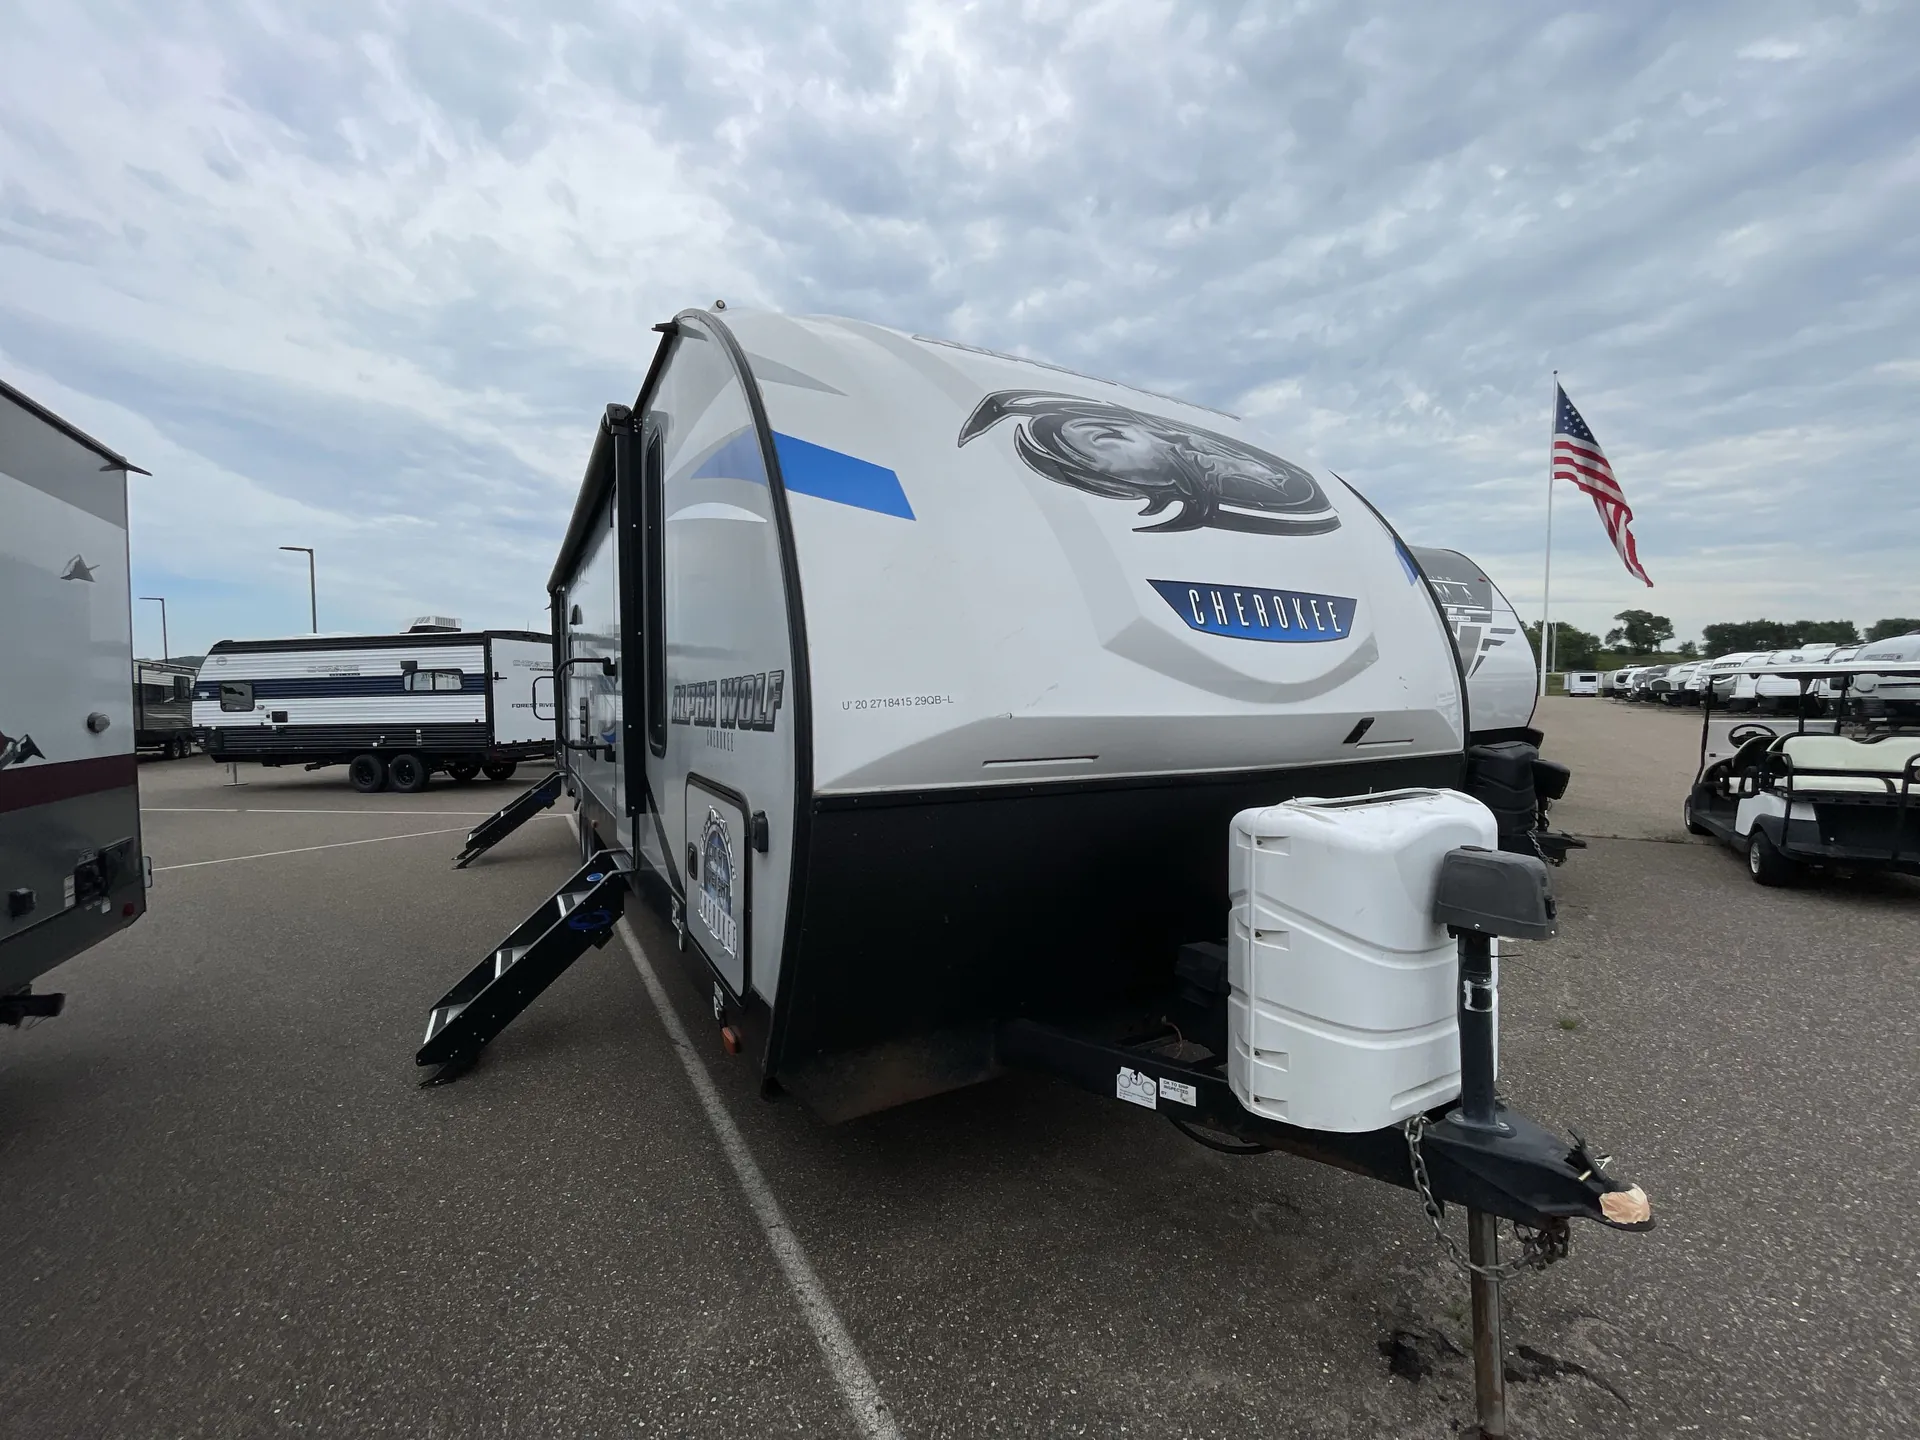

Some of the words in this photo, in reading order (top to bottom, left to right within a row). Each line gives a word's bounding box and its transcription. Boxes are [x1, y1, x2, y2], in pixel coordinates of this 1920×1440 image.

[1188, 588, 1342, 633] CHEROKEE
[671, 680, 717, 727] ALPHA
[720, 669, 785, 733] WOLF
[855, 699, 868, 710] 20
[870, 696, 912, 709] 2718415
[915, 694, 954, 706] 29QB-L
